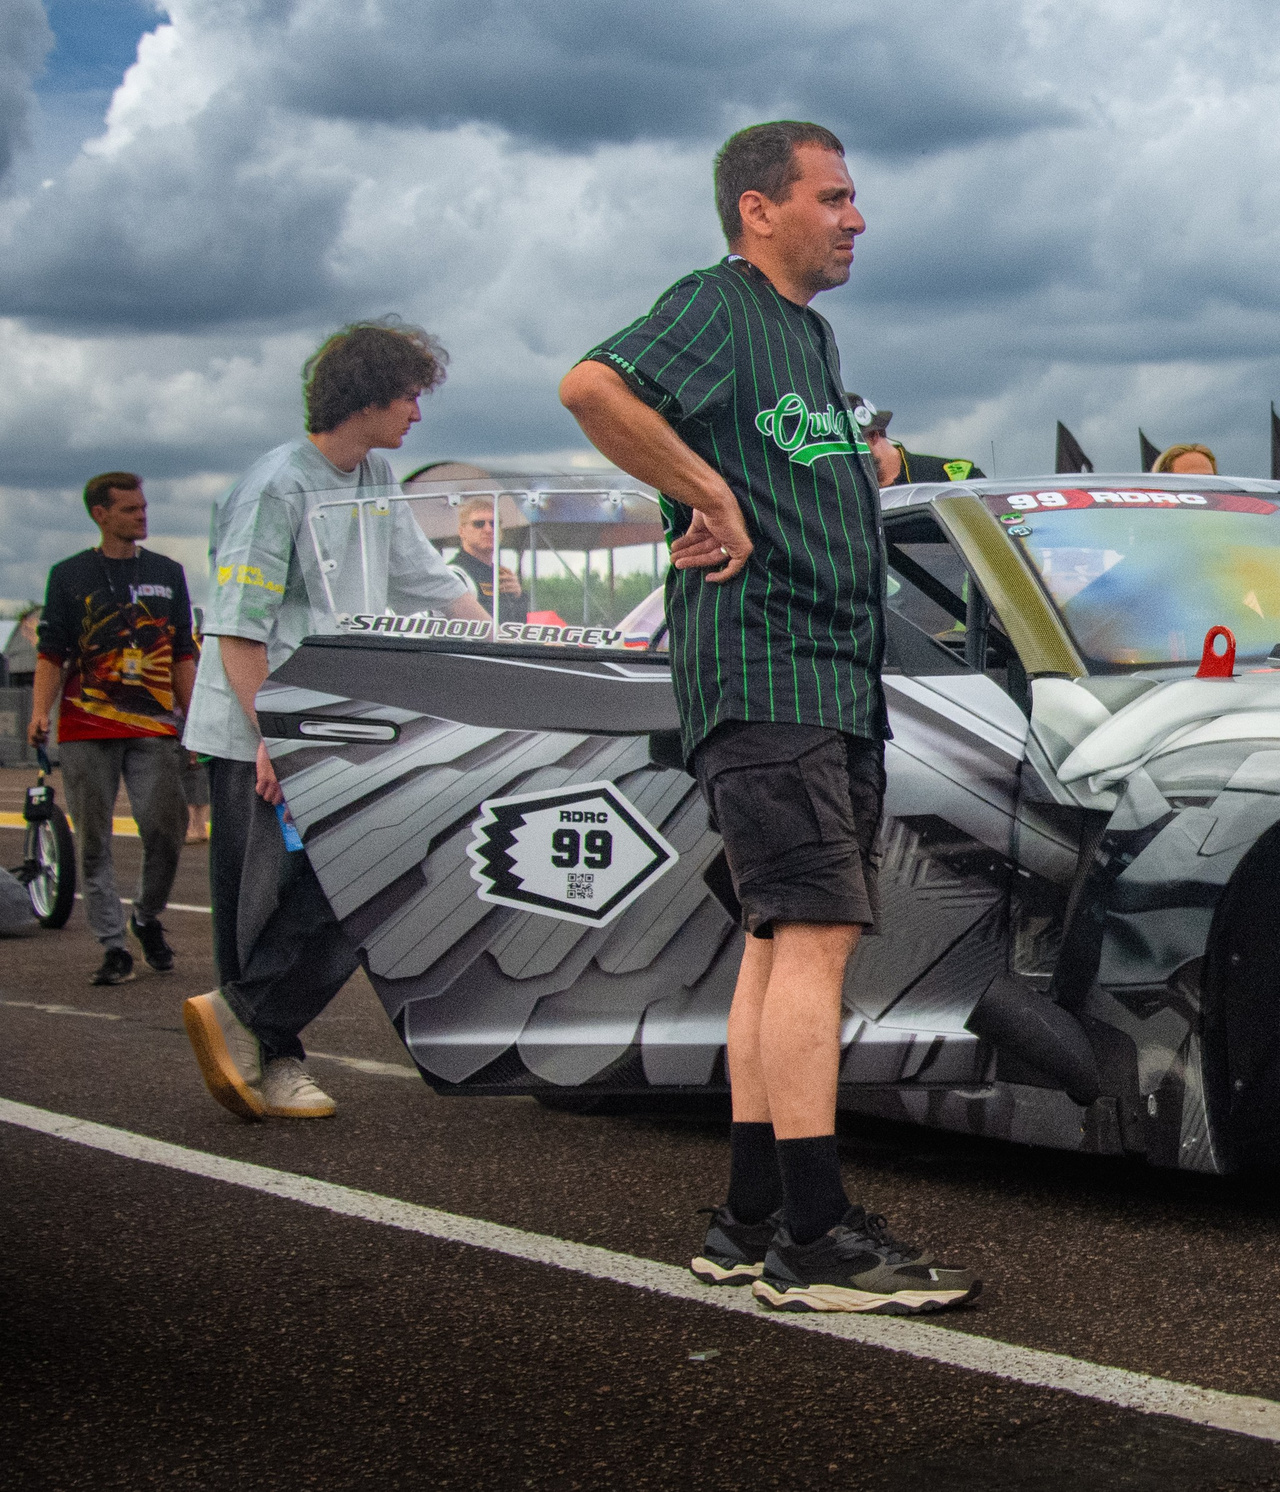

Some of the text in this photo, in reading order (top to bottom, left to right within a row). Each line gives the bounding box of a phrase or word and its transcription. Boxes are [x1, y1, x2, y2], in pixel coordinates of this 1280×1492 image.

[1006, 491, 1208, 510] 99 RDRC
[350, 614, 623, 647] SAVINOV SERGEY
[559, 810, 609, 824] RDRC
[551, 828, 613, 869] 99
